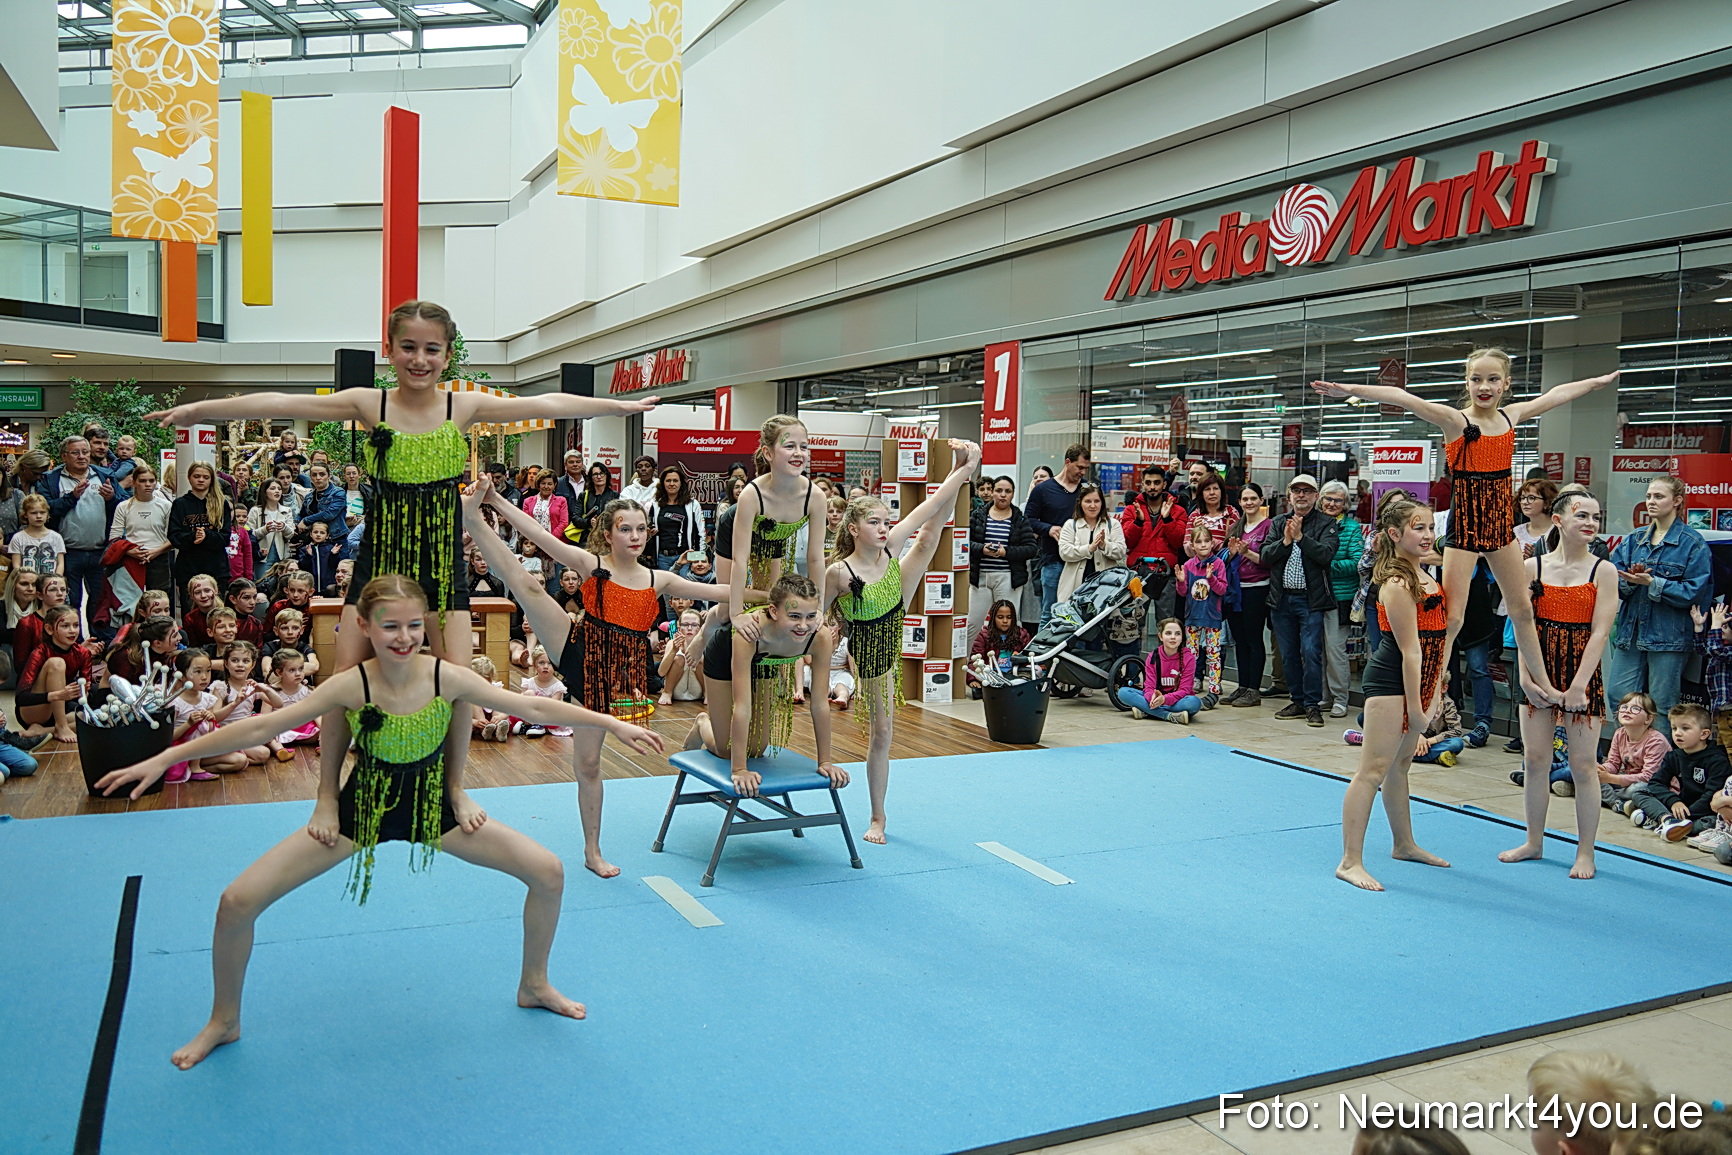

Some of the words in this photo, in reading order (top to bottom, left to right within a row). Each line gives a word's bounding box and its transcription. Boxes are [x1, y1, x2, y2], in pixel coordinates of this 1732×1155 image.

[994, 351, 1011, 411] 1
[990, 417, 1010, 428] Stunde
[1634, 433, 1704, 449] Smartbar
[1629, 476, 1653, 484] PRÄSE
